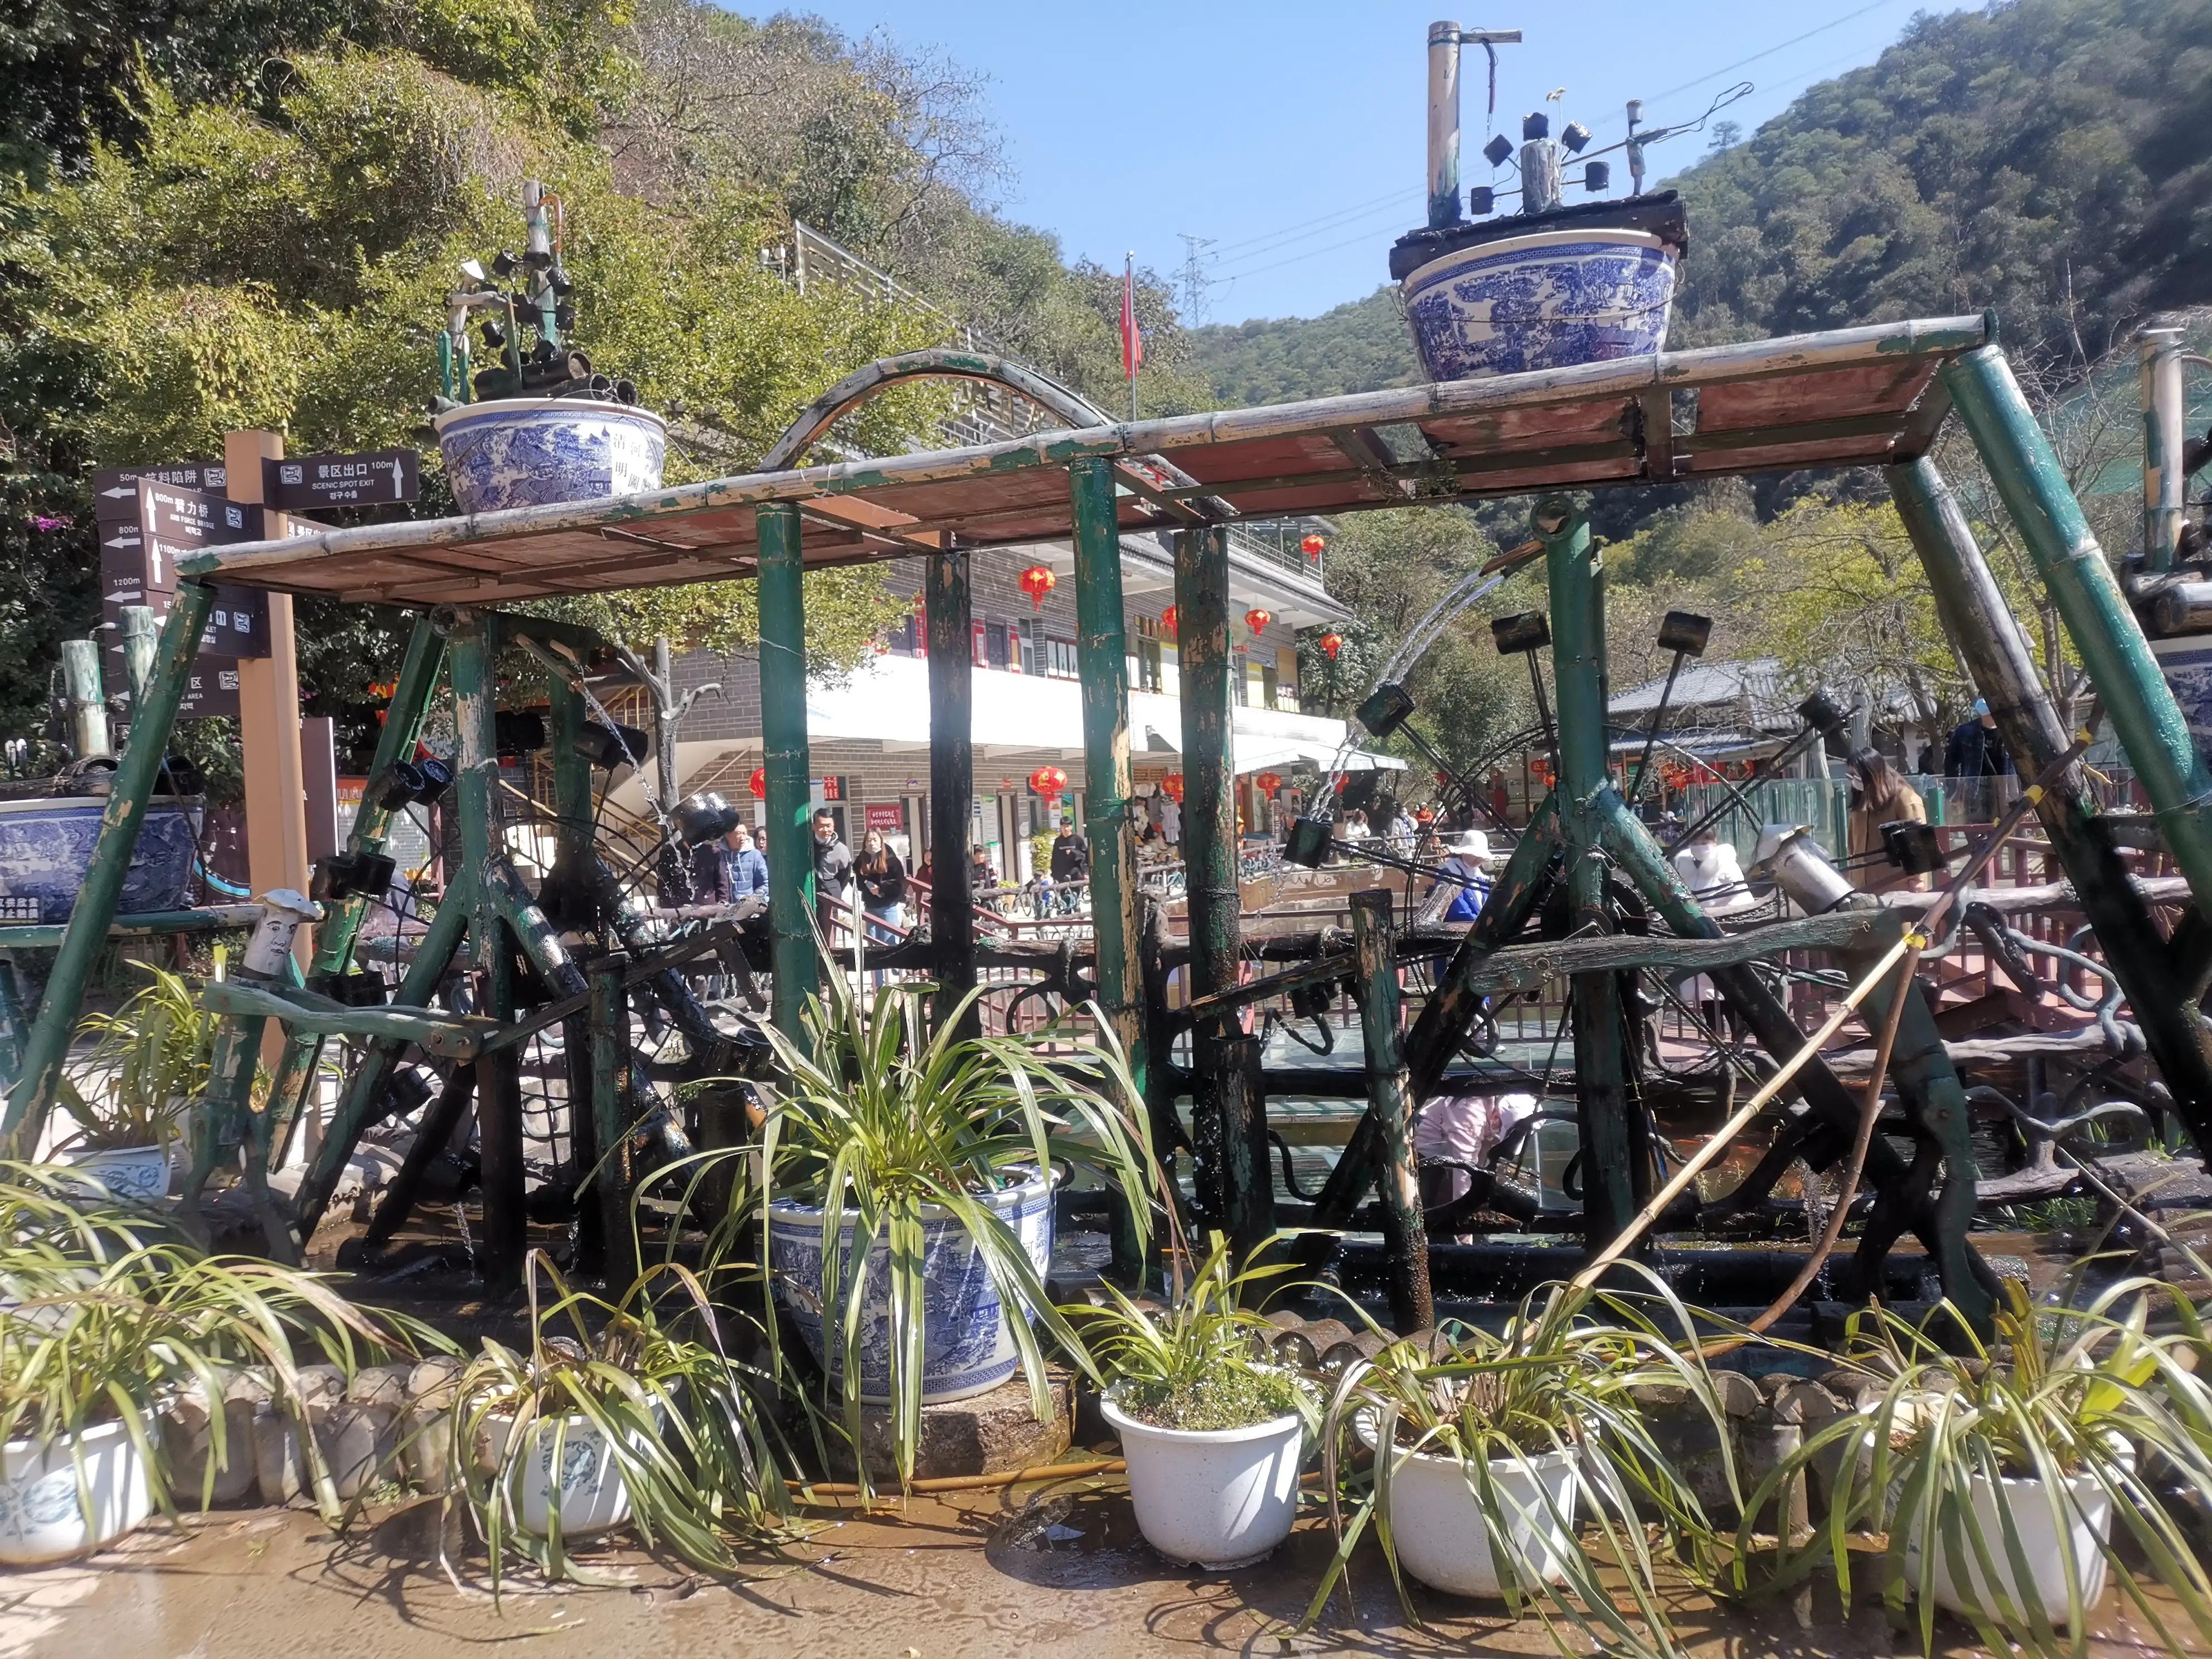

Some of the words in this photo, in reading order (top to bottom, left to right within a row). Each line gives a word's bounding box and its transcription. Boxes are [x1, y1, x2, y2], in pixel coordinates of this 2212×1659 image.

[318, 464, 367, 478] 景区出口
[614, 433, 627, 496] 清明
[338, 480, 358, 488] SPOT
[155, 493, 173, 504] 800m
[174, 498, 208, 518] 臂力桥
[181, 516, 196, 525] FORCE
[197, 520, 215, 529] BRIDGE
[113, 578, 140, 586] 1200m
